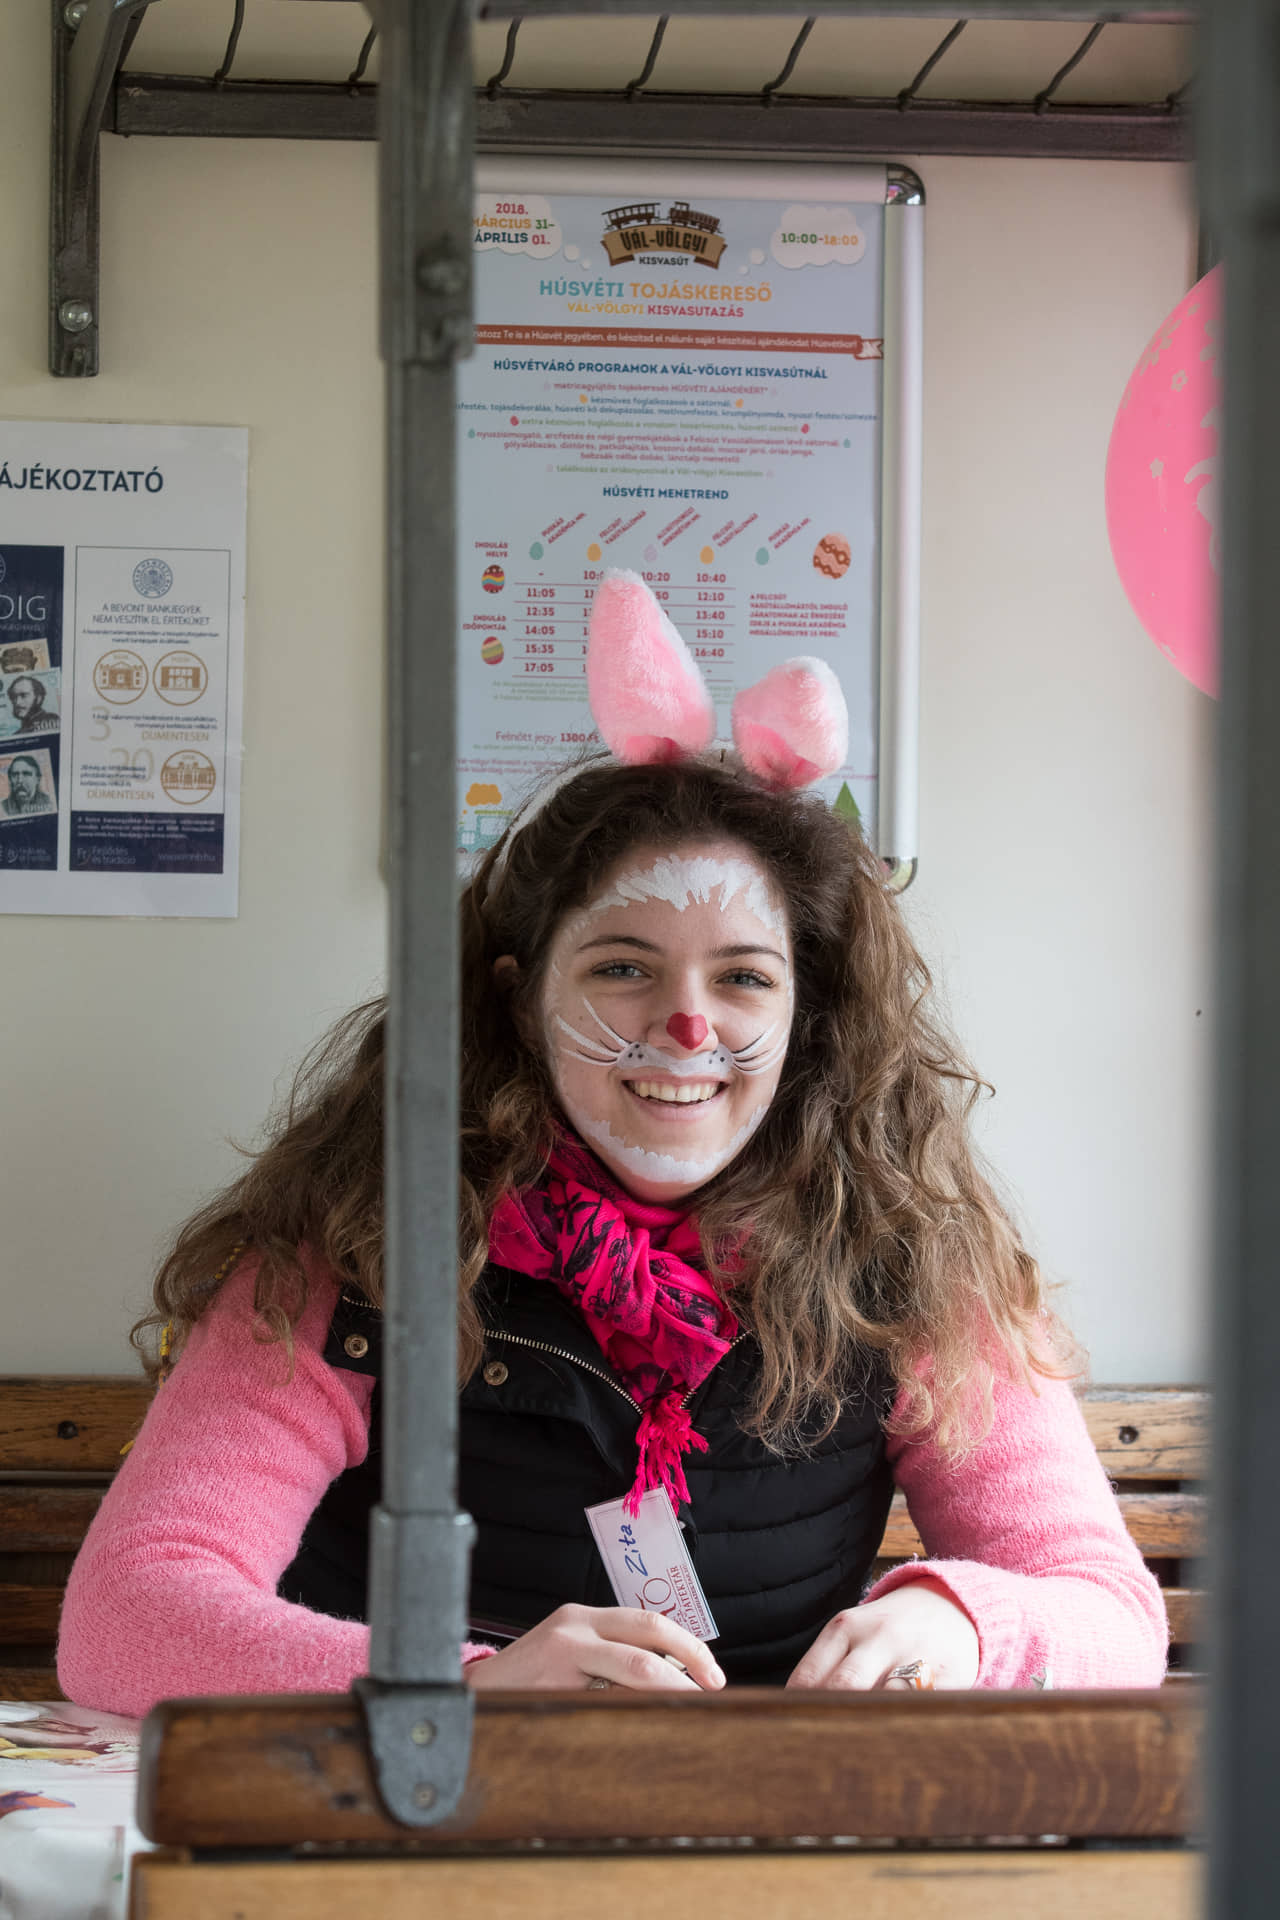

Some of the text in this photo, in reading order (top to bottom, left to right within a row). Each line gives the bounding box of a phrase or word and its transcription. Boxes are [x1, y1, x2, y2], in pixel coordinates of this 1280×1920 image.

[495, 203, 529, 215] 2018.
[535, 219, 555, 229] 31-
[474, 230, 551, 245] ÁPRILIS 01.
[620, 227, 708, 254] VÁL-VÖLGYI
[639, 256, 689, 266] KISVASÚT
[539, 277, 772, 302] HÚSVÉTI TOJÁSKERESŐ
[567, 300, 744, 317] VÁL-VÖLGYI KISVASUTAZÁS
[578, 362, 658, 374] PROGRAMOK
[660, 364, 669, 374] A
[670, 362, 742, 376] VÁL-VÖLGYI
[745, 366, 828, 379] KISVASÚTNÁL
[603, 485, 729, 499] HÚSVÉTI MENETREND
[696, 573, 726, 583] 10:40
[526, 588, 555, 598] 11:05
[697, 592, 725, 602] 12:10
[110, 604, 145, 613] BEVONT
[526, 607, 555, 616] 12:35
[93, 615, 112, 624] NEM
[696, 610, 725, 620] 13:40
[525, 625, 555, 635] 14:05
[696, 629, 724, 639] 15:10
[525, 644, 554, 654] 15:35
[695, 648, 724, 657] 16:40
[524, 663, 554, 672] 17:05
[618, 1524, 648, 1577] Zita
